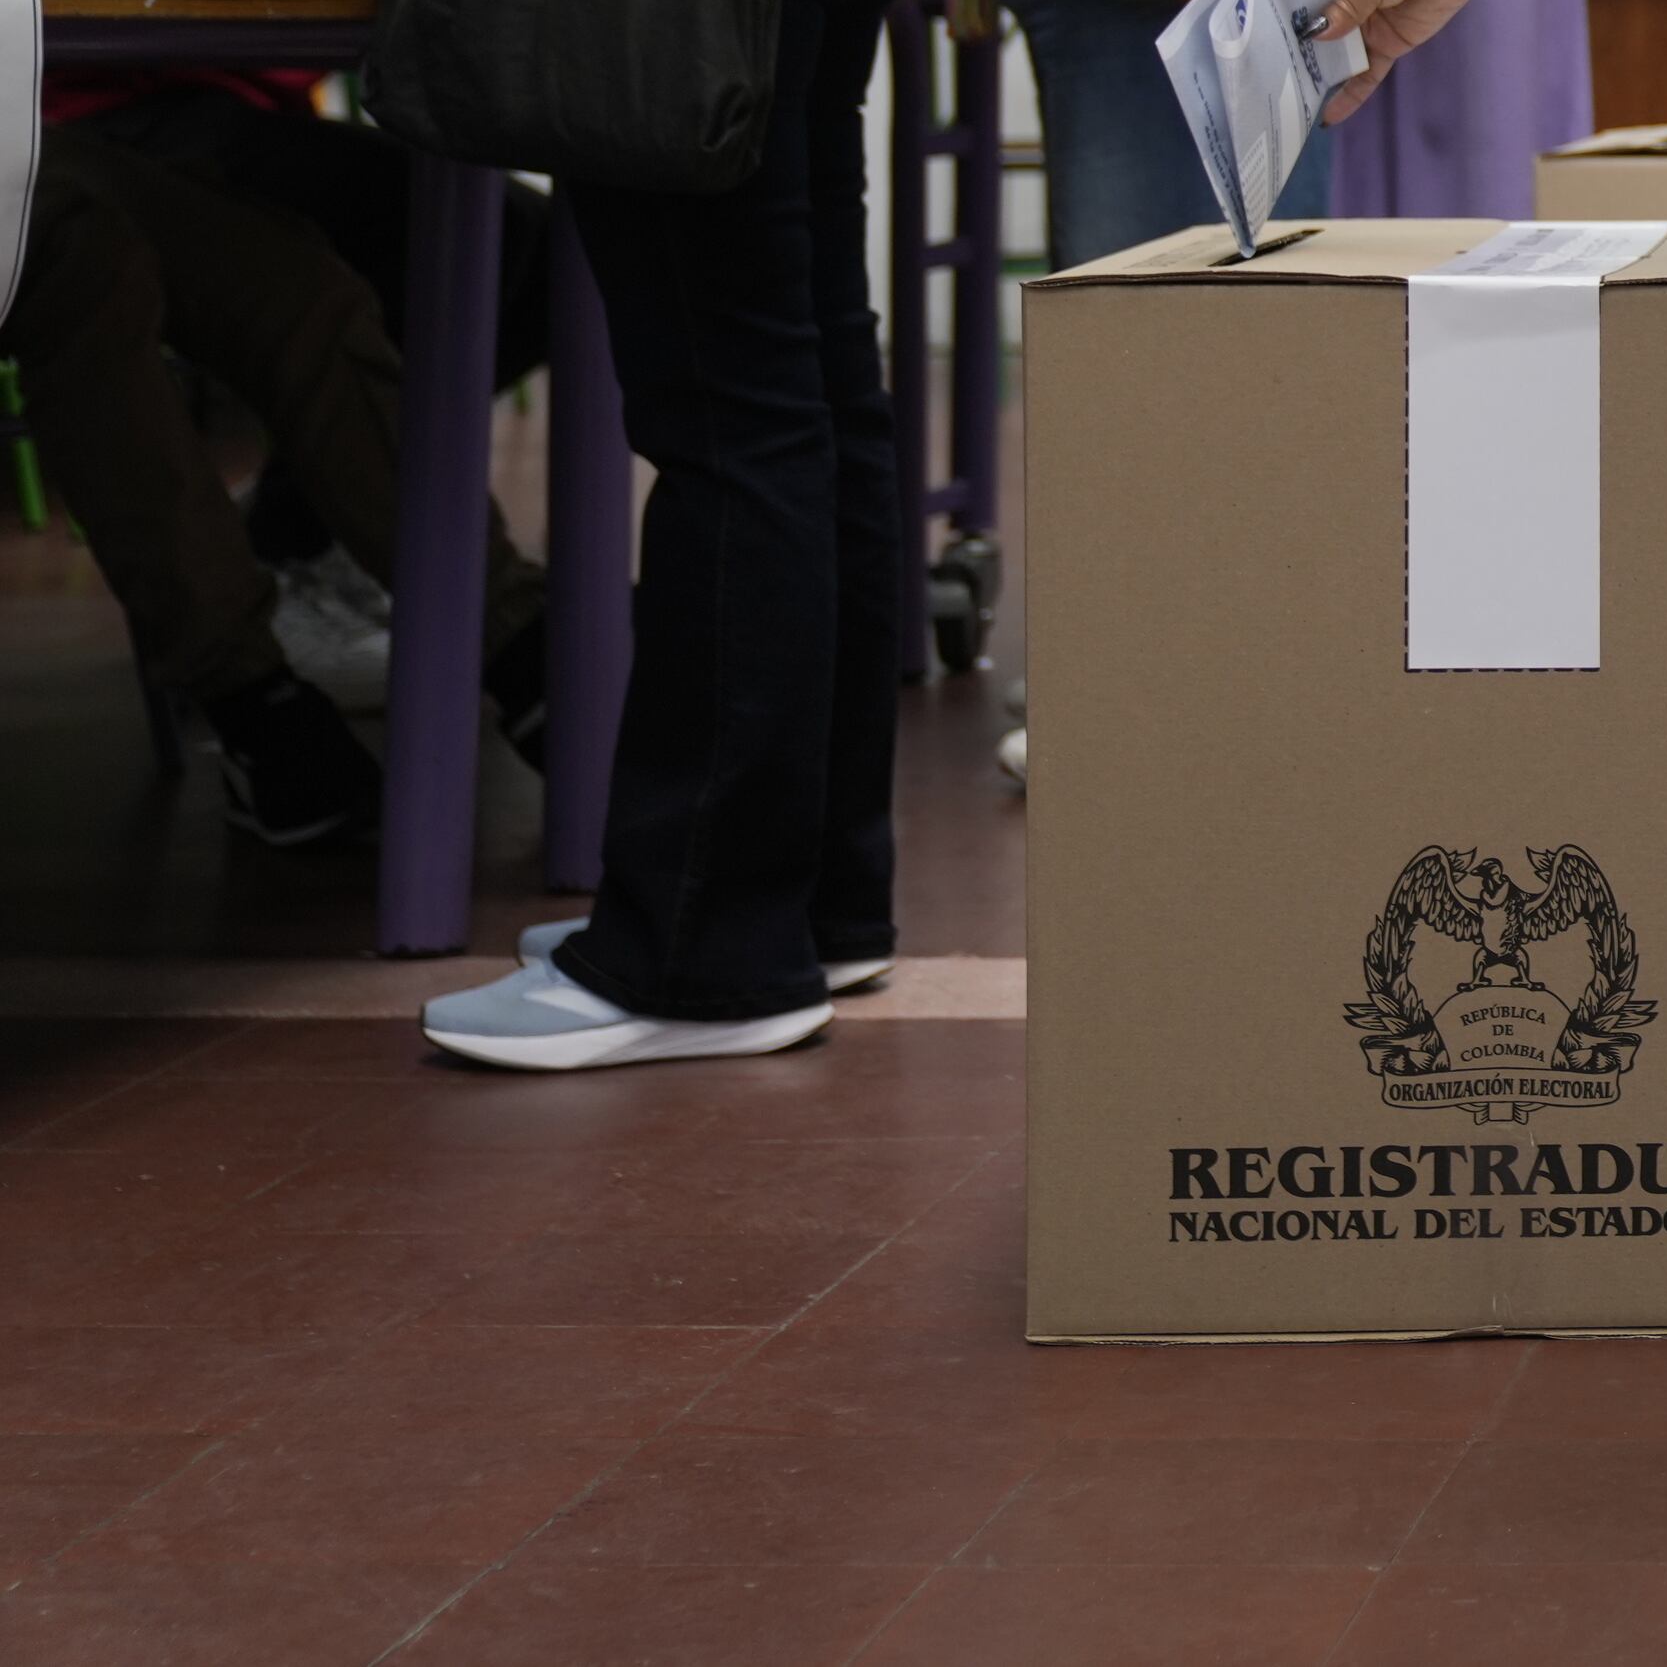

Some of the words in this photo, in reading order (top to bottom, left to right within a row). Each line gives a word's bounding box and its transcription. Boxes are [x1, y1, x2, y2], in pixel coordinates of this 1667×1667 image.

[1460, 1004, 1546, 1026] REPÚBLICA
[1492, 1024, 1514, 1036] DE
[1460, 1043, 1545, 1063] COLOMBIA
[1389, 1074, 1514, 1102] ORGANIZACIÓN
[1519, 1078, 1614, 1100] ELECTORAL
[1168, 1203, 1398, 1244] NACIONAL
[1413, 1205, 1506, 1241] DEL
